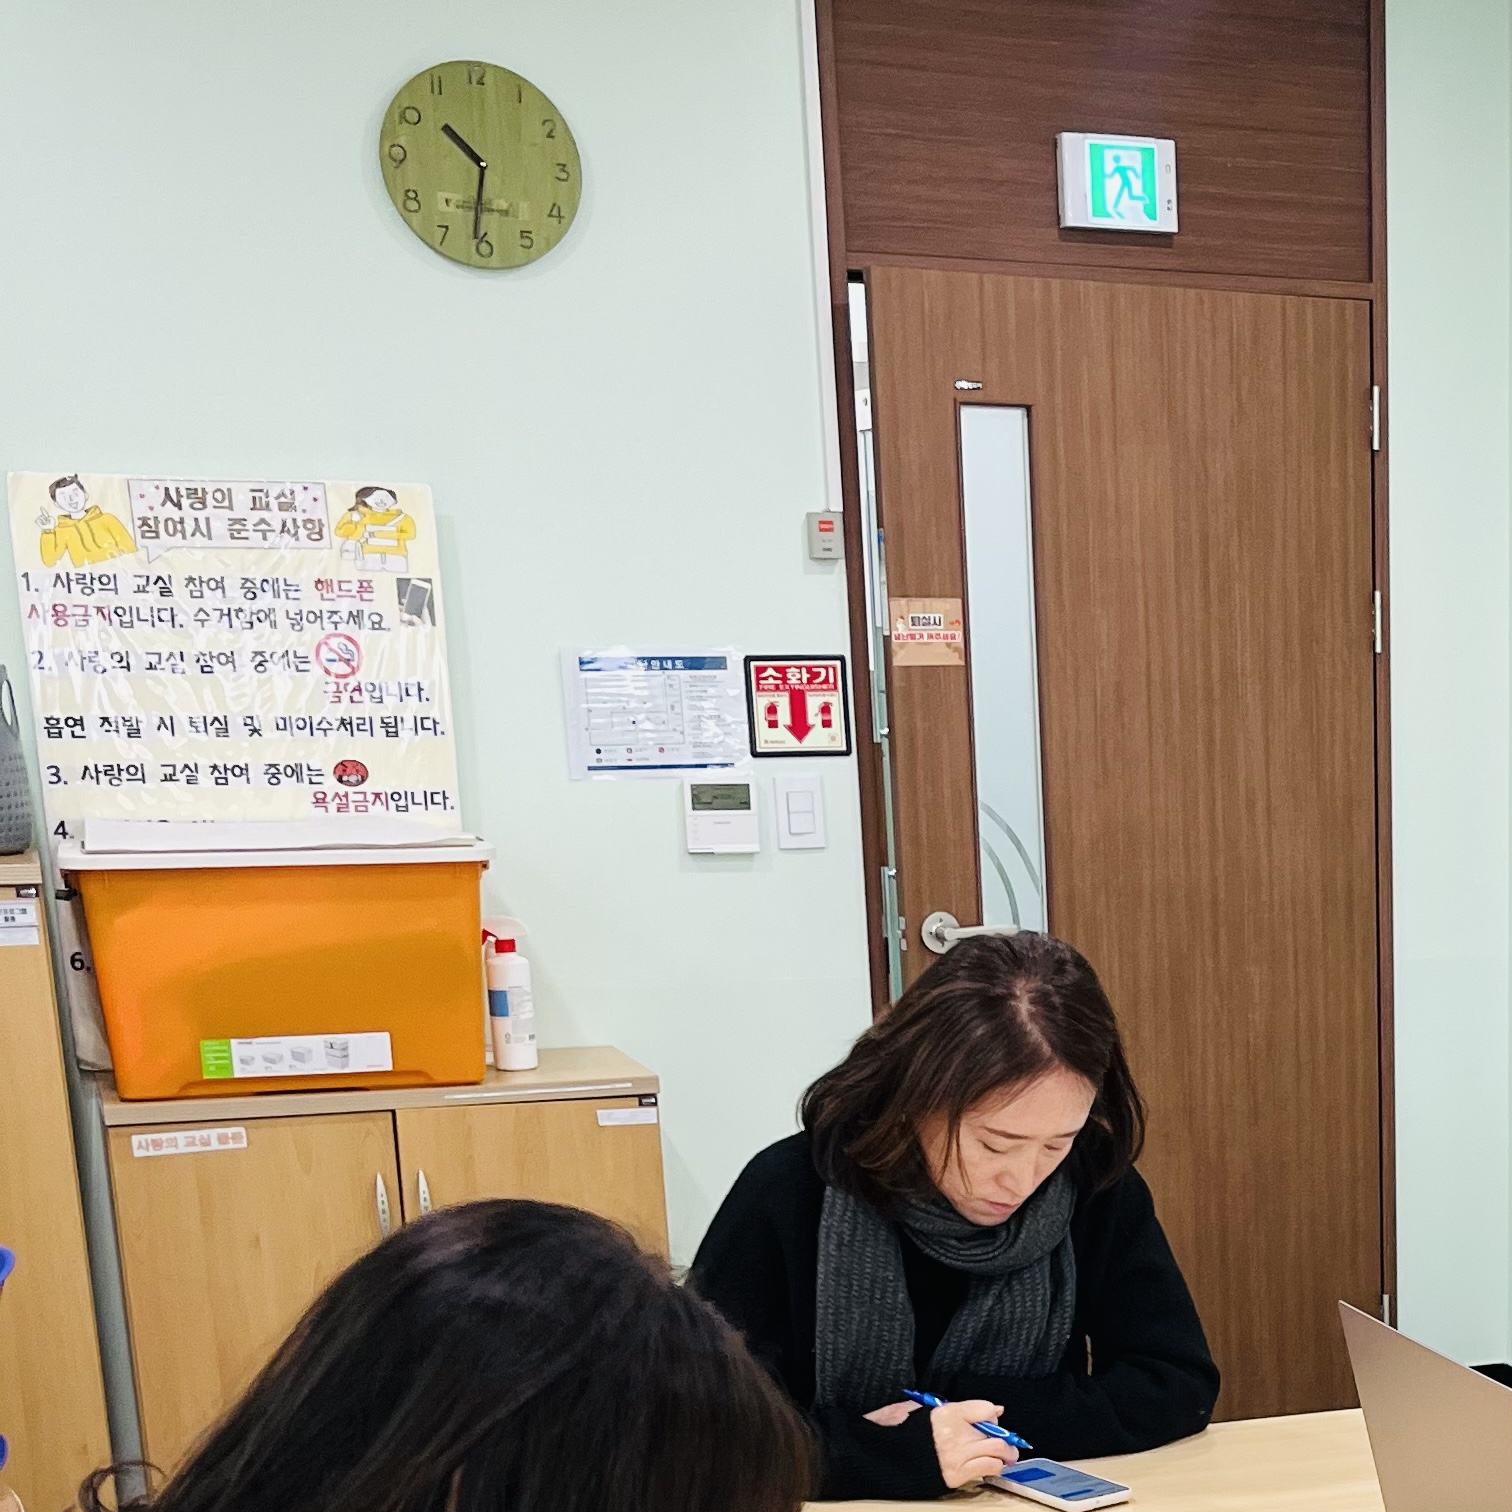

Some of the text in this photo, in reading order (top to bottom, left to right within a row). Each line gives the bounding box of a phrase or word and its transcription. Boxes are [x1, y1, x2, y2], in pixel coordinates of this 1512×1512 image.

[429, 74, 443, 96] 11
[467, 64, 486, 86] 12
[516, 83, 523, 103] 1
[399, 105, 422, 126] 10
[541, 119, 557, 139] 2
[388, 143, 407, 169] 9
[555, 163, 571, 183] 3
[402, 188, 422, 213] 8
[547, 203, 565, 224] 4
[437, 225, 449, 246] 7
[475, 231, 494, 259] 6
[519, 230, 534, 250] 5
[160, 486, 298, 513] 사랑의 교실
[137, 516, 325, 542] 참여시 준수사항
[21, 572, 375, 602] 1. 사랑의 교실 참여 중에는 핸드폰
[27, 603, 391, 632] 사용금지입니다. 수거함에 넣어주세요.
[31, 650, 311, 675] 2. 사랑의 교실 참여 중에는
[758, 667, 835, 684] 소화기
[323, 681, 430, 704] 금연입니다.
[44, 715, 87, 739] 흡연
[99, 715, 143, 739] 적발
[156, 715, 176, 737] 시
[188, 715, 231, 738] 퇴실
[242, 715, 263, 738] 및
[46, 762, 325, 787] 3. 사랑의 교실 참여 중에는
[311, 790, 455, 813] 욕설금지입니다.
[53, 820, 75, 840] 4.
[70, 951, 92, 972] 6.
[136, 1135, 179, 1153] 사랑의
[183, 1133, 212, 1148] 교실
